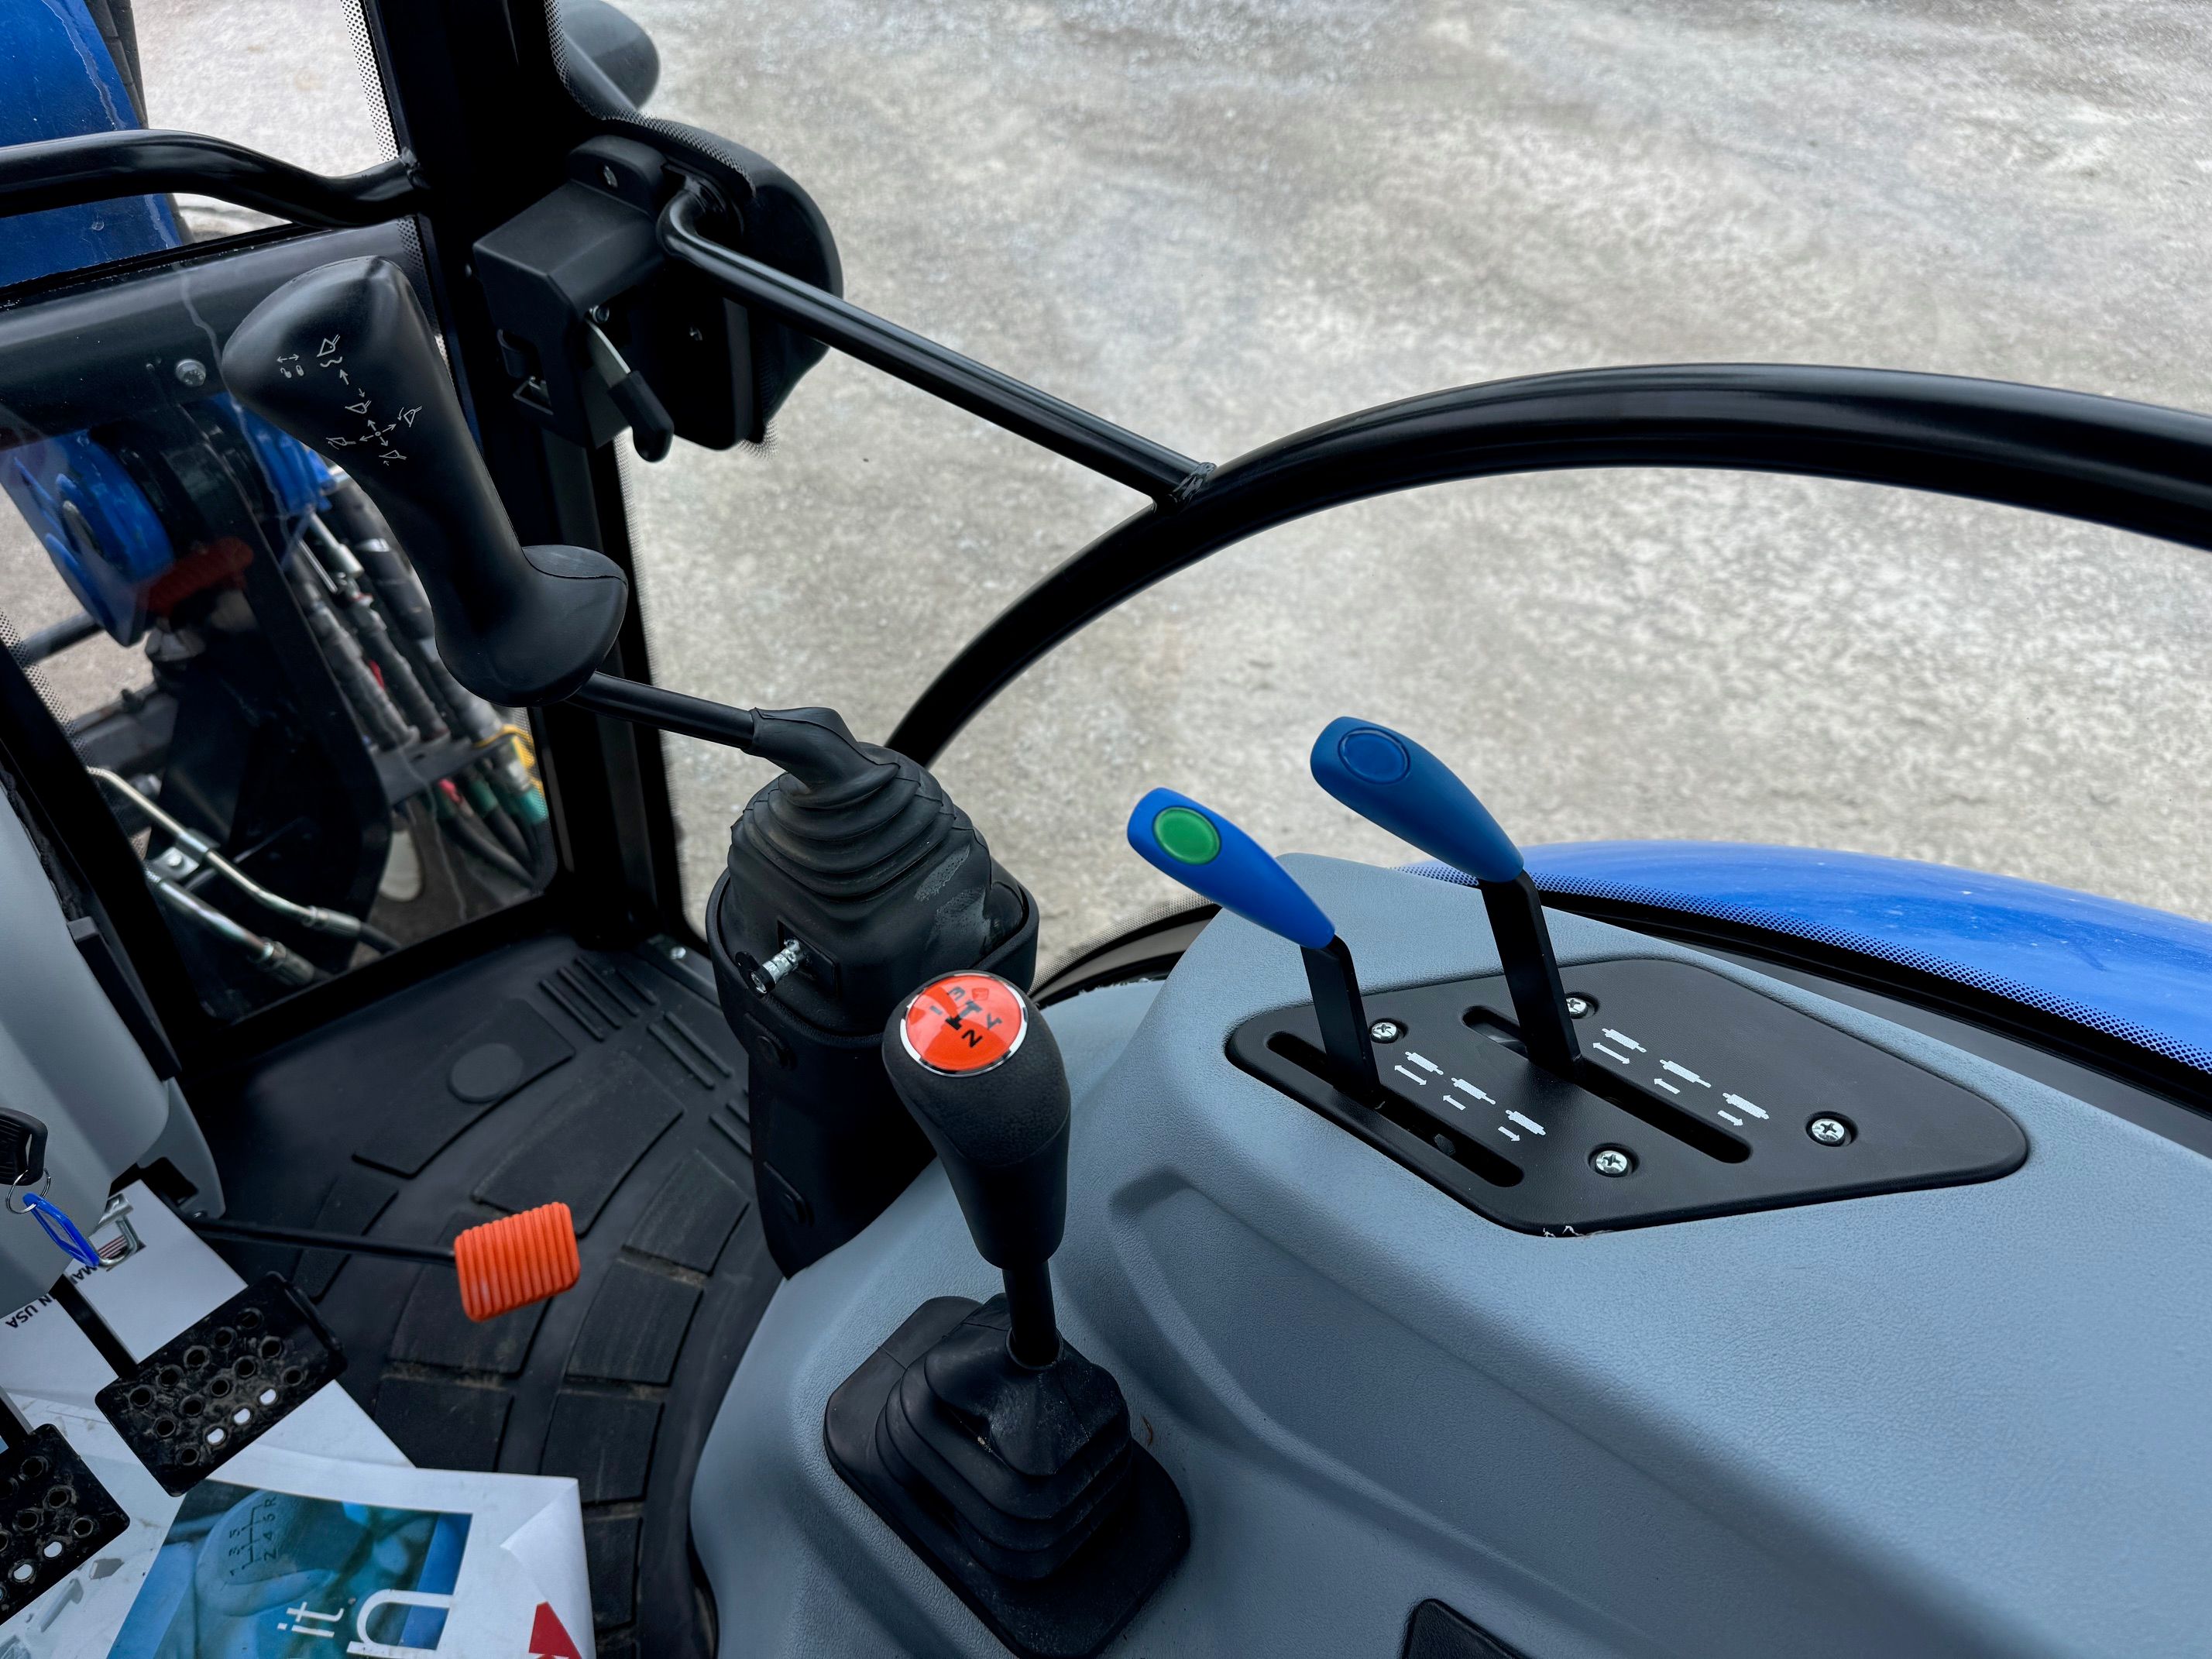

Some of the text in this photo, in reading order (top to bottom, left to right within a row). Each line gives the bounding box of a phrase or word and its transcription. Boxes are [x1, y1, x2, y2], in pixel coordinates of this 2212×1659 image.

[947, 986, 966, 1001] 3
[5, 1305, 39, 1329] USA
[264, 1495, 277, 1507] R
[263, 1530, 273, 1541] 4
[228, 1546, 240, 1557] 3
[263, 1548, 277, 1561] 2
